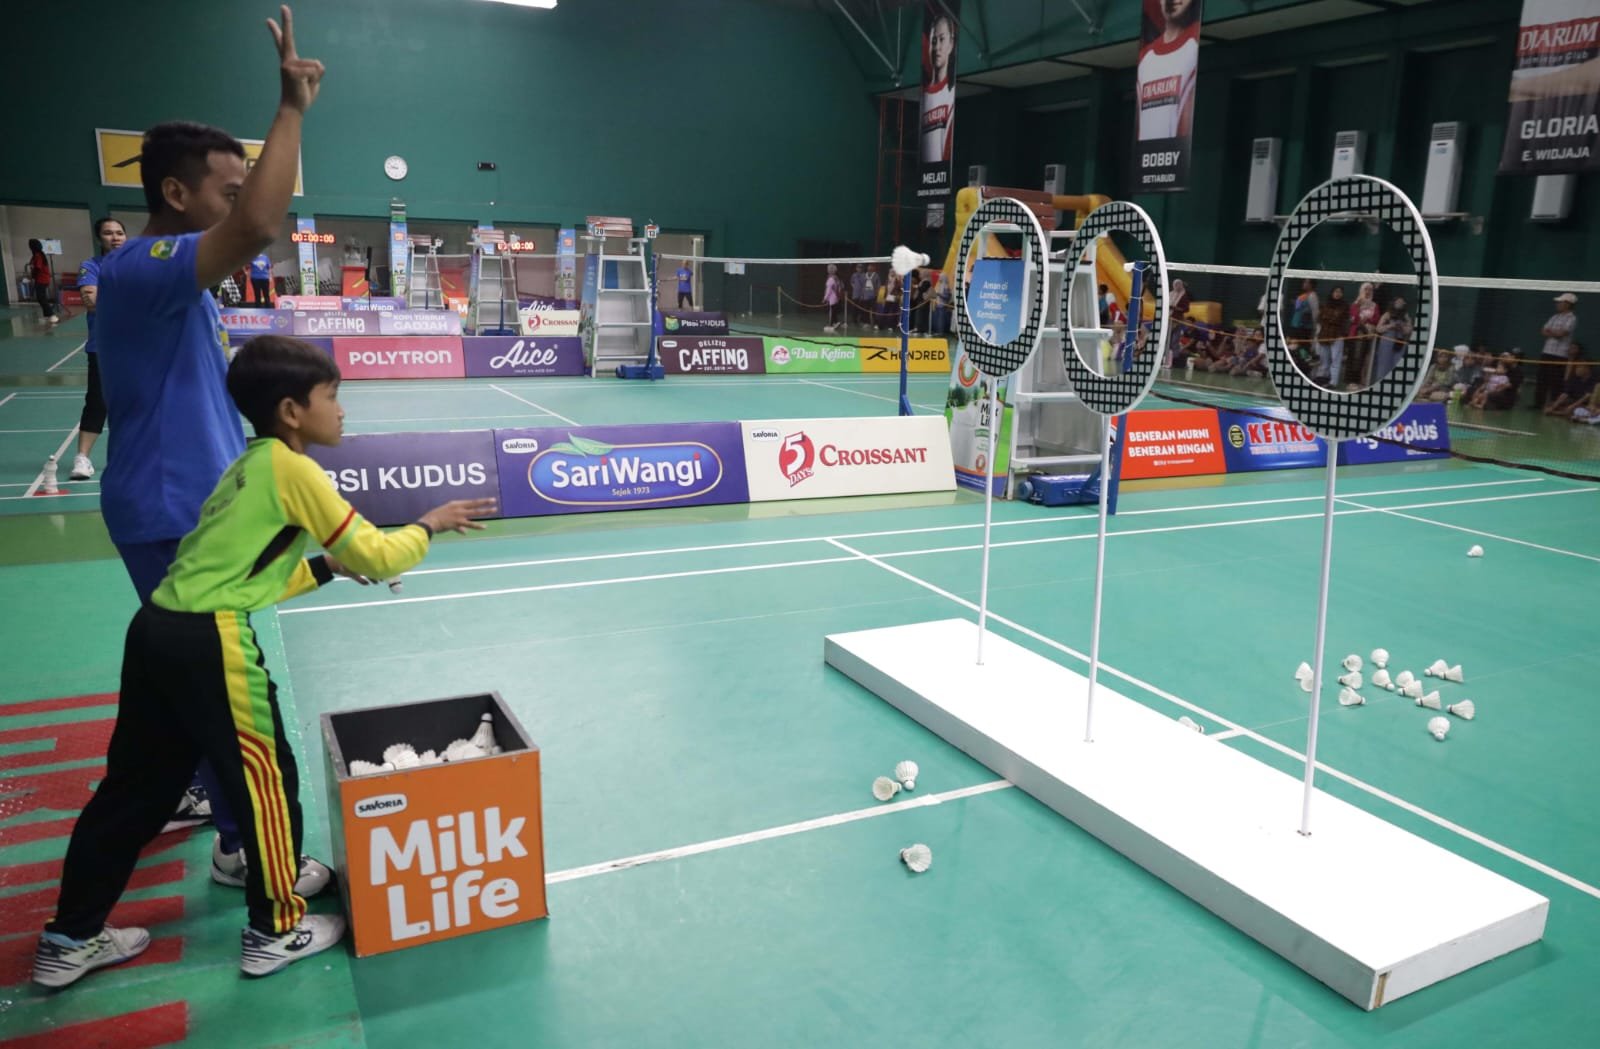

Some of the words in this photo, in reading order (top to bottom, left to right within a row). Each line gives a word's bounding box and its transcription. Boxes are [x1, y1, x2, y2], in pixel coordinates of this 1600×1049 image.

[1519, 22, 1599, 50] DJARUM
[1520, 114, 1599, 139] GLORIA
[1142, 151, 1180, 167] BOBBY
[1535, 147, 1590, 161] WIDJAJA
[922, 172, 947, 184] MELATI
[1142, 173, 1176, 183] SETIABUDI
[291, 233, 335, 243] 00:00:00
[220, 314, 270, 324] KENKO
[307, 318, 366, 333] CAFFINO
[542, 318, 578, 326] CROISSAN
[698, 340, 727, 348] DELIZIO
[349, 350, 452, 365] POLYTRON
[489, 340, 558, 369] Aice
[679, 348, 748, 371] CAFFINO
[791, 347, 818, 359] Dua
[820, 347, 855, 362] Kelinci
[752, 431, 778, 439] SAVORIA
[1128, 430, 1176, 443] BENERAN
[1176, 428, 1210, 440] MURNI
[504, 440, 536, 450] SAVORIA
[1128, 445, 1176, 458] BENERAN
[1176, 442, 1215, 455] RINGAN
[785, 431, 808, 475] 5
[819, 444, 928, 467] CROISSANT
[377, 462, 487, 490] KUDUS
[550, 452, 703, 489] SariWangi
[789, 467, 815, 488] DAYS
[633, 486, 651, 496] 1973
[357, 798, 404, 813] SAVORIA
[369, 806, 529, 886] Milk
[386, 869, 520, 942] Life
